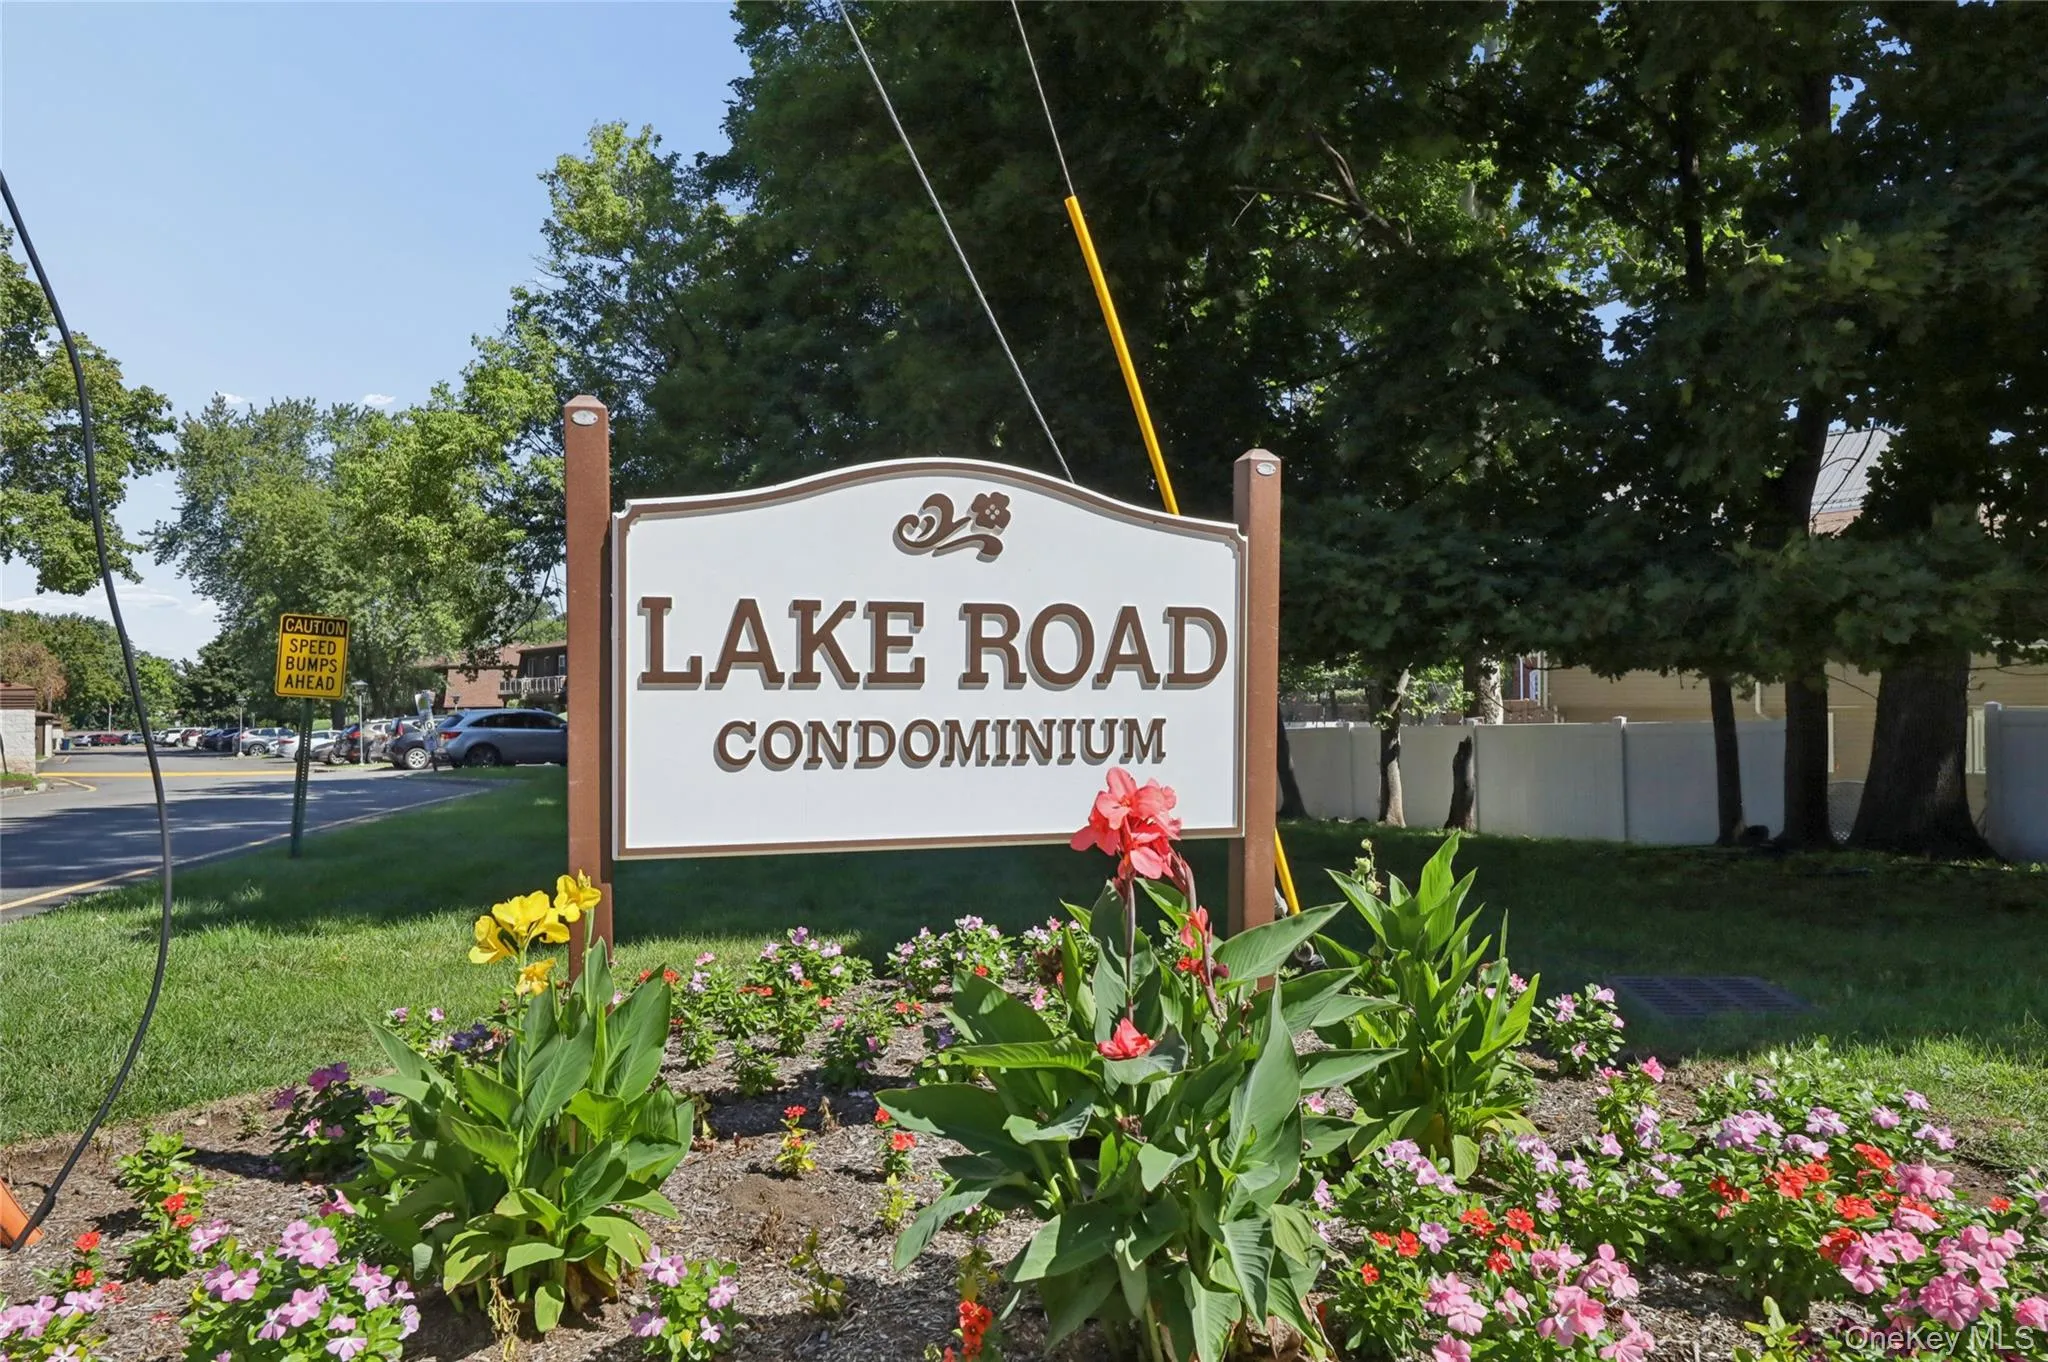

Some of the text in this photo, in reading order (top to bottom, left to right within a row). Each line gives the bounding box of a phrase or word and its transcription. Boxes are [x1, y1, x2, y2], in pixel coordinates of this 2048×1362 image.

[286, 618, 344, 635] CAUTION
[289, 638, 336, 655] SPEED
[637, 596, 1229, 691] LAKE ROAD
[285, 656, 337, 673] BUMPS
[284, 674, 335, 690] AHEAD
[713, 717, 1167, 771] CONDOMINIUM
